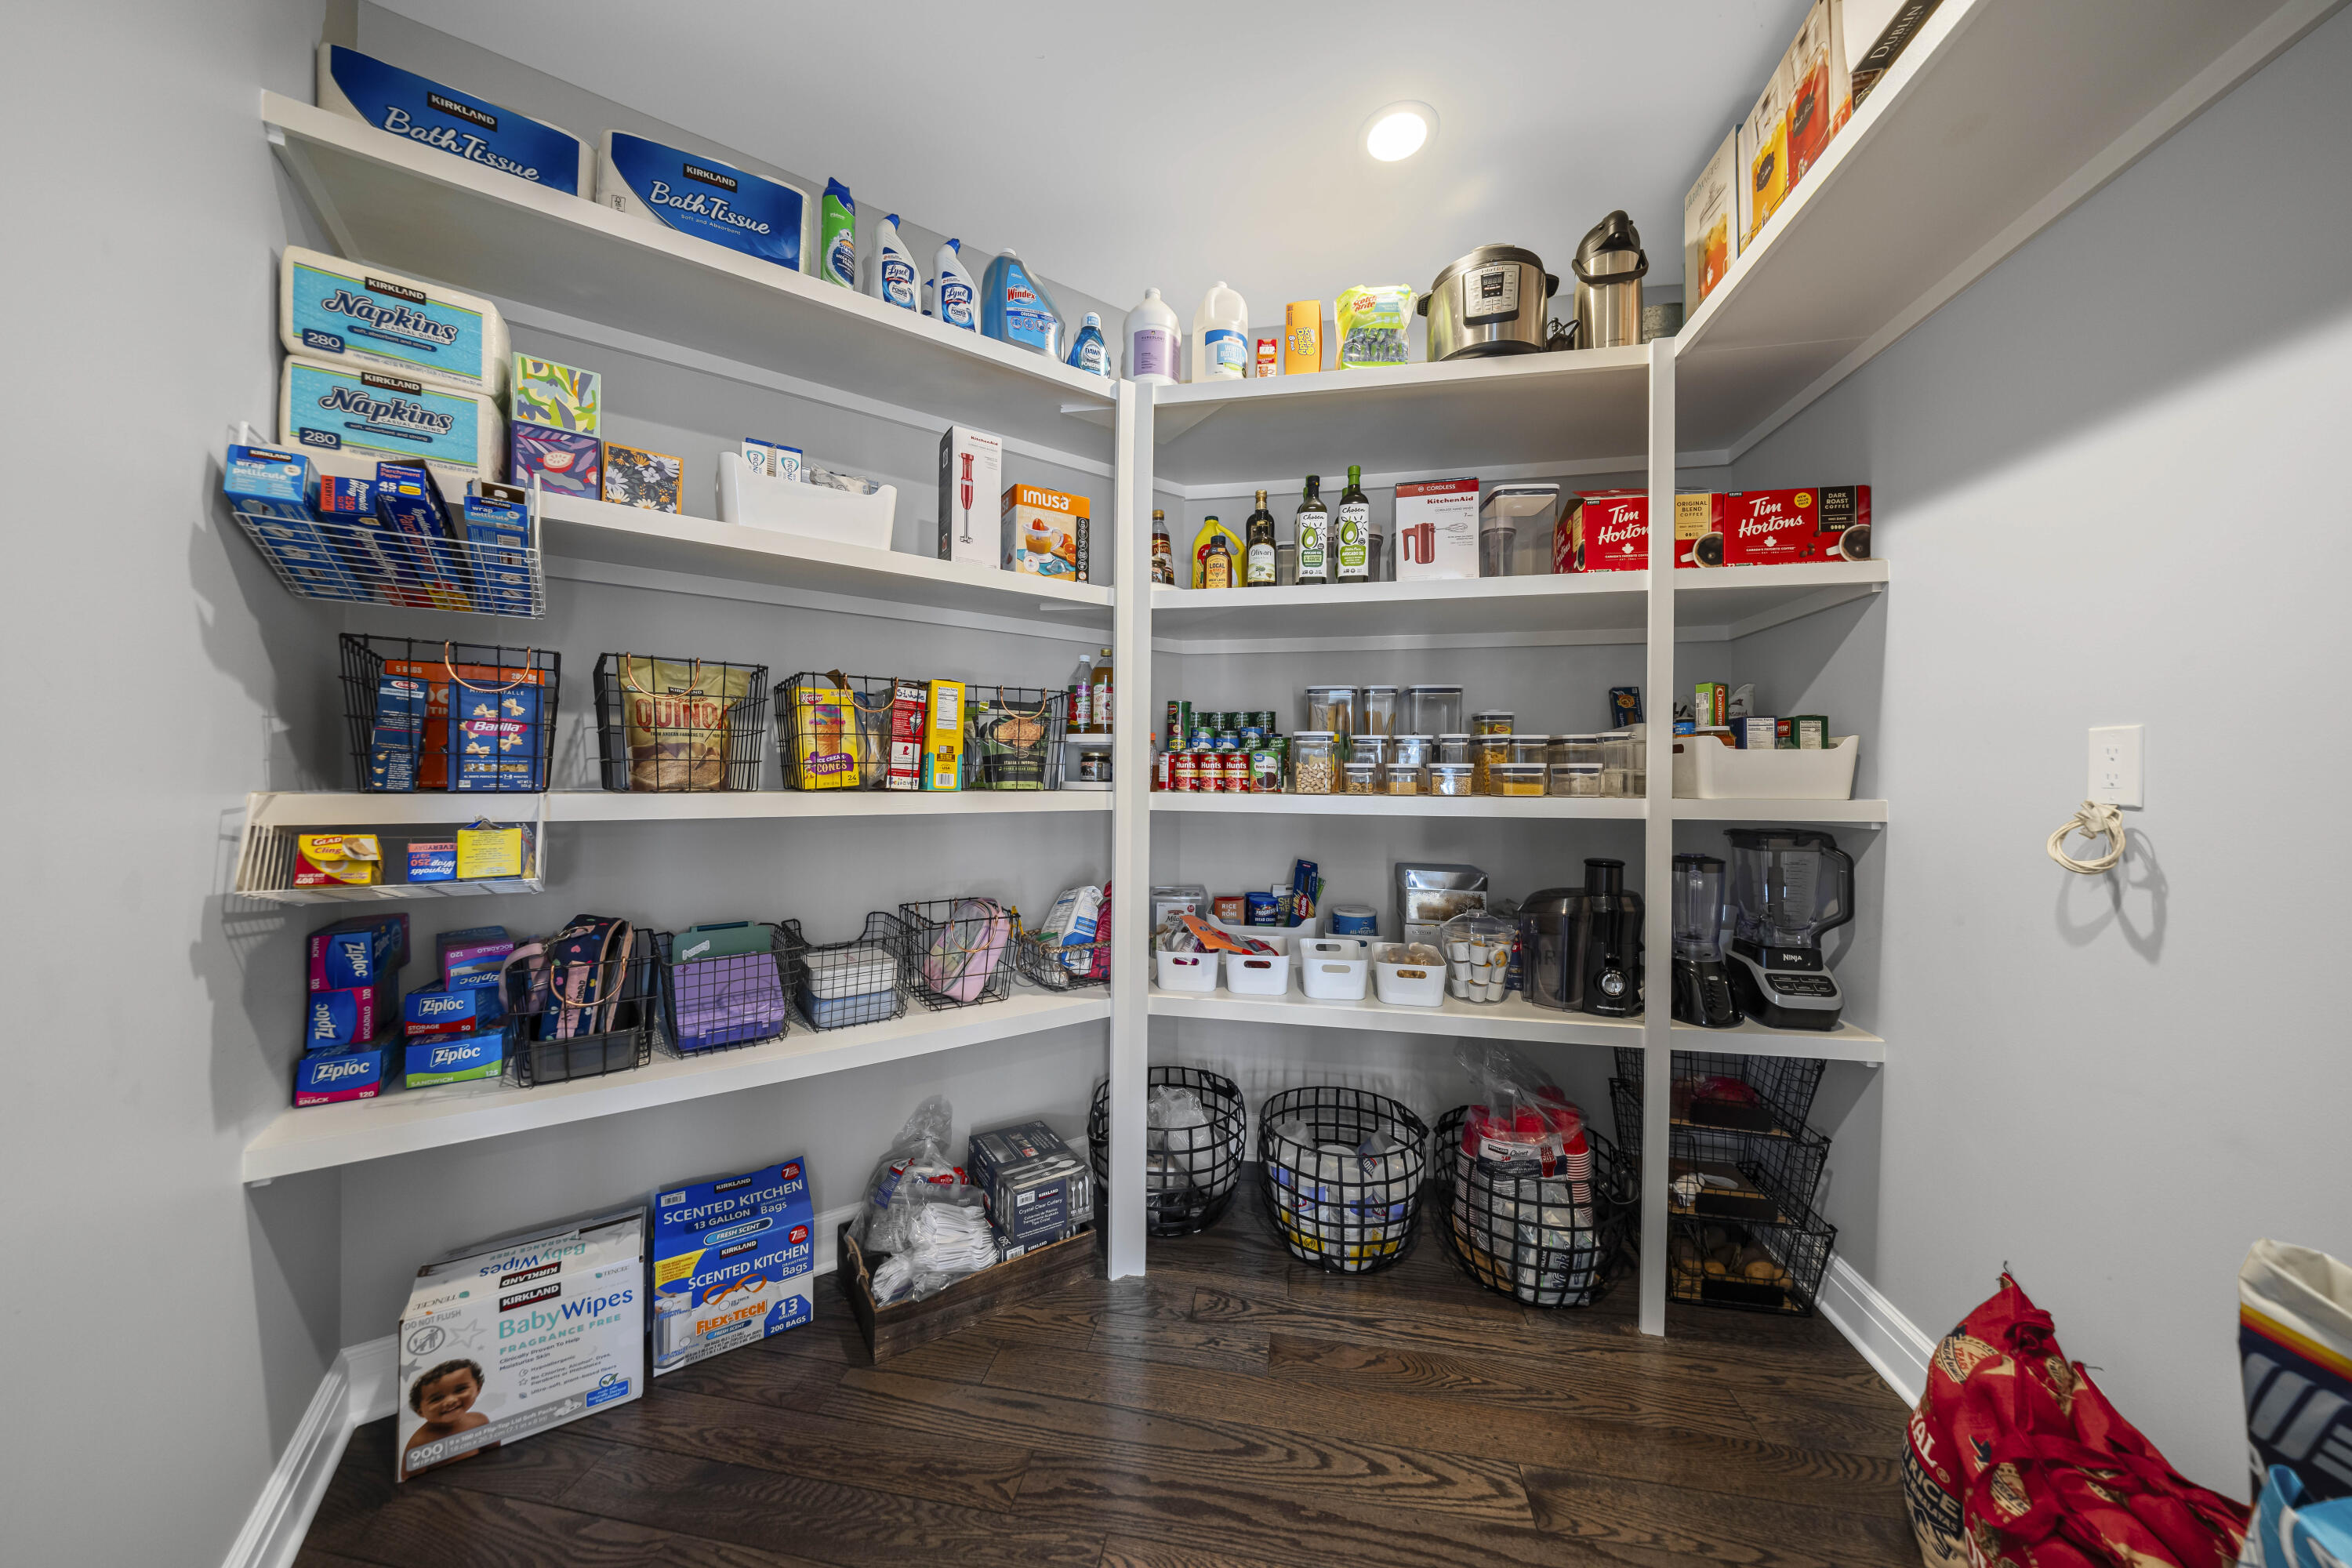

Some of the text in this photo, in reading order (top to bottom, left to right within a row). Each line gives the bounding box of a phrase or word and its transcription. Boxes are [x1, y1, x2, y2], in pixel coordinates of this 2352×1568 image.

[1869, 5, 1923, 59] DUBLIN
[431, 95, 495, 125] KIRKLAND
[384, 106, 540, 180] Bath Tissue
[685, 165, 736, 188] KIRKLAND
[650, 181, 771, 235] Bath Tissue
[681, 213, 695, 222] Soft
[710, 221, 741, 236] Absorbent
[887, 264, 909, 277] Lysol
[368, 279, 425, 300] KIRKLAND
[946, 287, 967, 299] Lysol
[1007, 288, 1036, 301] Windex
[1352, 295, 1380, 307] Scotch
[1355, 301, 1377, 312] Brite
[321, 289, 459, 343] Napkins
[308, 332, 341, 349] 280
[386, 325, 446, 343] CASUAL DINING
[1296, 328, 1308, 356] Daddy
[1304, 326, 1315, 347] Scrub
[365, 374, 420, 391] KIRKLAND
[319, 387, 454, 433] Napkins
[381, 418, 442, 433] CASUAL DINING
[303, 430, 336, 445] 280
[971, 435, 998, 446] KitchenAid
[250, 449, 292, 460] KIRKLAND
[237, 459, 266, 470] wrap
[380, 468, 421, 478] Parchment
[232, 467, 287, 481] pellicule
[347, 478, 358, 497] Wrap
[379, 481, 397, 490] 45
[345, 495, 355, 510] 250
[358, 481, 370, 512] Reynolds
[481, 499, 511, 508] KIRKLAND
[1427, 495, 1474, 504] KitchenAid
[1608, 504, 1639, 524] Tim
[1749, 496, 1782, 517] Tim
[1597, 523, 1650, 546] Horton
[1738, 515, 1803, 539] Hortons
[636, 698, 728, 733] QUINOA
[817, 760, 848, 774] CONES
[313, 837, 343, 846] GLAD
[410, 859, 456, 876] Reynolds Wrap
[477, 943, 514, 954] BOCADILLO
[345, 942, 368, 978] Ziploc
[1782, 953, 1802, 963] NINJA
[362, 989, 371, 1000] 120
[422, 998, 465, 1015] Ziploc
[315, 1004, 336, 1040] Ziploc
[362, 1005, 371, 1040] BOCADILLO
[434, 1047, 481, 1065] Ziploc
[317, 1062, 370, 1082] Ziploc
[410, 1076, 454, 1087] SANDWICH
[298, 1097, 329, 1105] SNACK
[783, 1168, 789, 1178] 7
[716, 1178, 751, 1191] KIRKLAND
[663, 1179, 803, 1225] SCENTED KITCHEN
[1038, 1189, 1059, 1199] KIRKLAND
[760, 1201, 787, 1214] Bags
[1018, 1206, 1035, 1214] Crystal
[1047, 1197, 1063, 1207] Cutlery
[694, 1209, 750, 1230] 13 GALLON
[717, 1222, 760, 1240] FRESH SCENT
[790, 1231, 797, 1241] 7
[721, 1240, 757, 1256] KIRKLAND
[1027, 1240, 1047, 1251] KIRKLAND
[479, 1242, 586, 1277] Baby Wipes
[688, 1262, 750, 1290] SCENTED
[754, 1243, 809, 1270] KITCHEN
[782, 1256, 808, 1268] DRAWSTRING
[502, 1265, 558, 1287] KIRKLAND
[603, 1265, 630, 1276] TENCEL
[782, 1263, 808, 1277] Bags
[415, 1294, 459, 1310] TENCEL
[502, 1284, 559, 1307] KIRKLAND
[499, 1308, 561, 1340] Baby
[561, 1289, 633, 1320] Wipes
[778, 1298, 798, 1316] 13
[779, 1310, 797, 1320] GALLON
[404, 1308, 462, 1331] DO NOT FLUSH
[695, 1301, 768, 1336] FLEX-TECH
[771, 1315, 806, 1334] 200 BAGS
[499, 1314, 622, 1356] FRAGRANCE FREE
[714, 1323, 745, 1337] FRESH SCENT
[499, 1336, 581, 1364] Clinically Proven Help
[499, 1358, 534, 1371] Moisturize
[410, 1443, 444, 1461] 900
[1909, 1457, 1960, 1519] RICE
